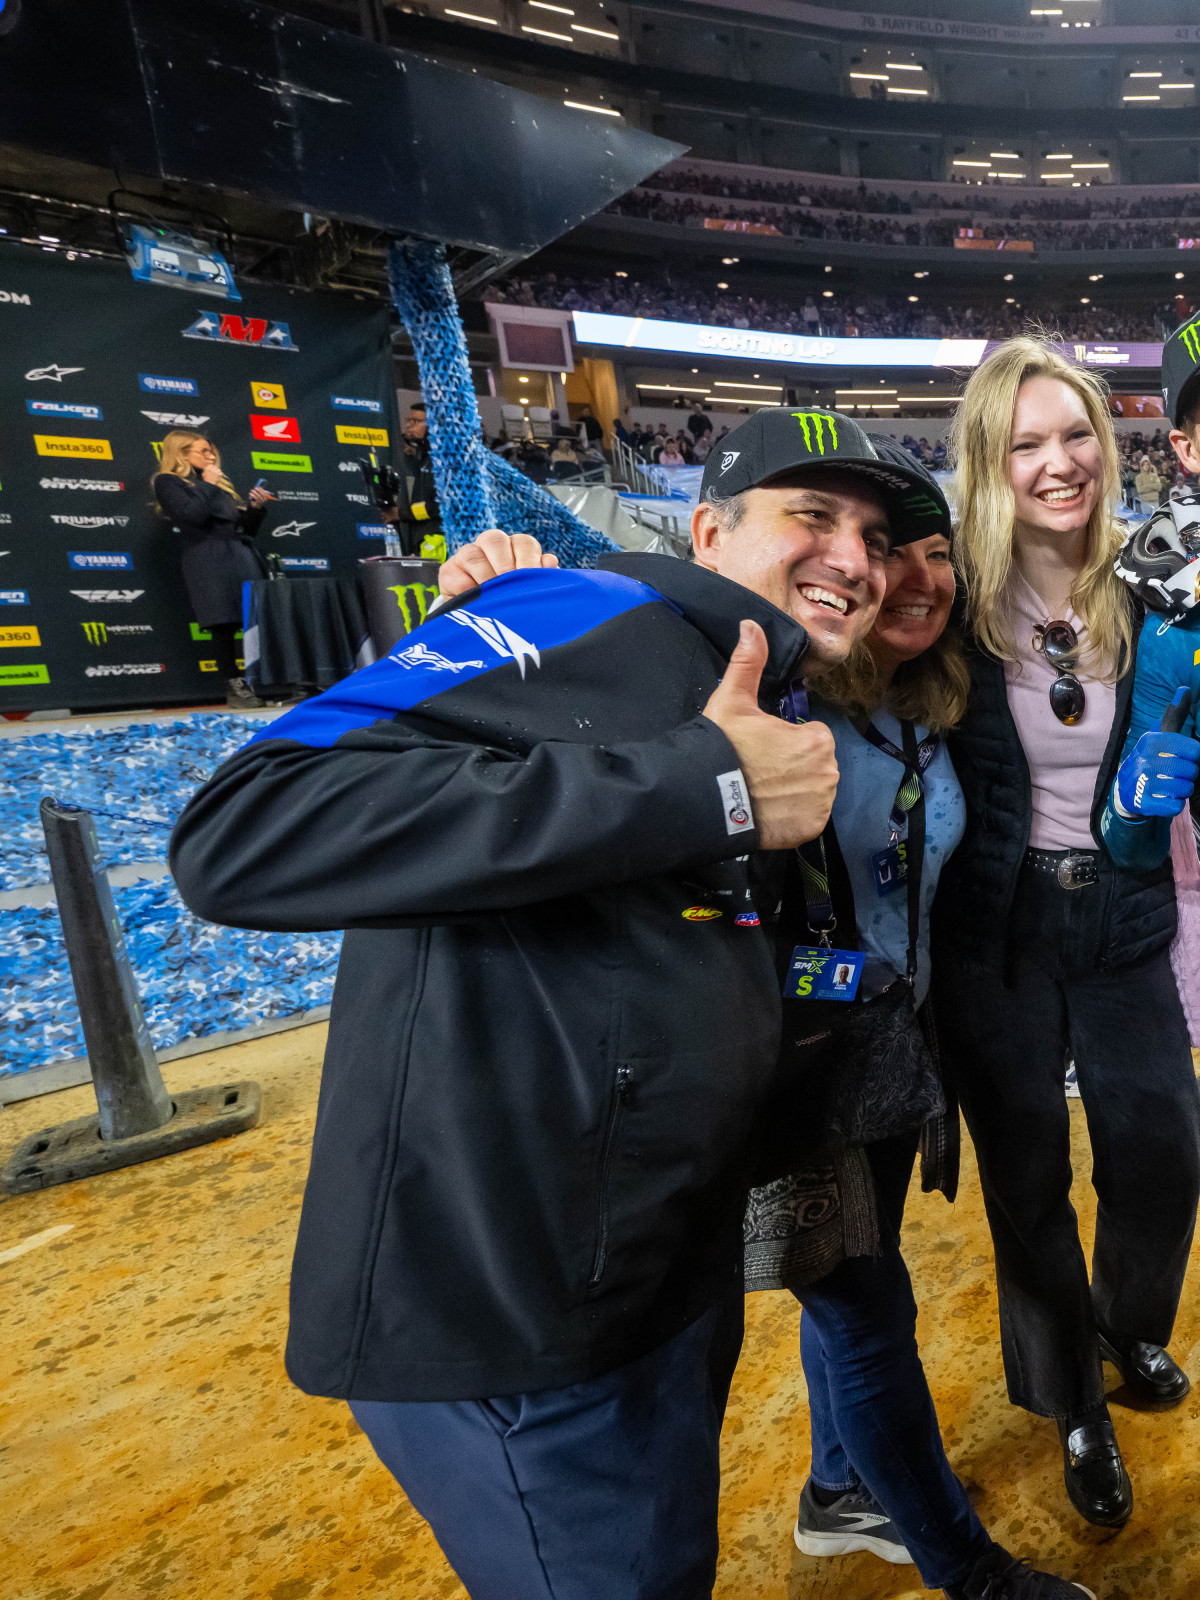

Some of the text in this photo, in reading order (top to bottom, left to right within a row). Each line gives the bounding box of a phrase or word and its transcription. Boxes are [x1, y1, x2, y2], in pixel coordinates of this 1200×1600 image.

[882, 18, 944, 34] RAYFIELD
[181, 310, 298, 349] AMA
[698, 330, 835, 358] SIGHTING LAP
[156, 379, 194, 391] YAMAHA
[32, 402, 98, 414] FALKEN
[334, 398, 380, 408] FALKEN
[46, 442, 104, 454] Insta360
[50, 515, 115, 528] TRIUMPH
[86, 555, 128, 565] YAMAHA
[1133, 773, 1149, 809] THOR
[793, 960, 827, 974] SMX
[795, 975, 814, 996] S
